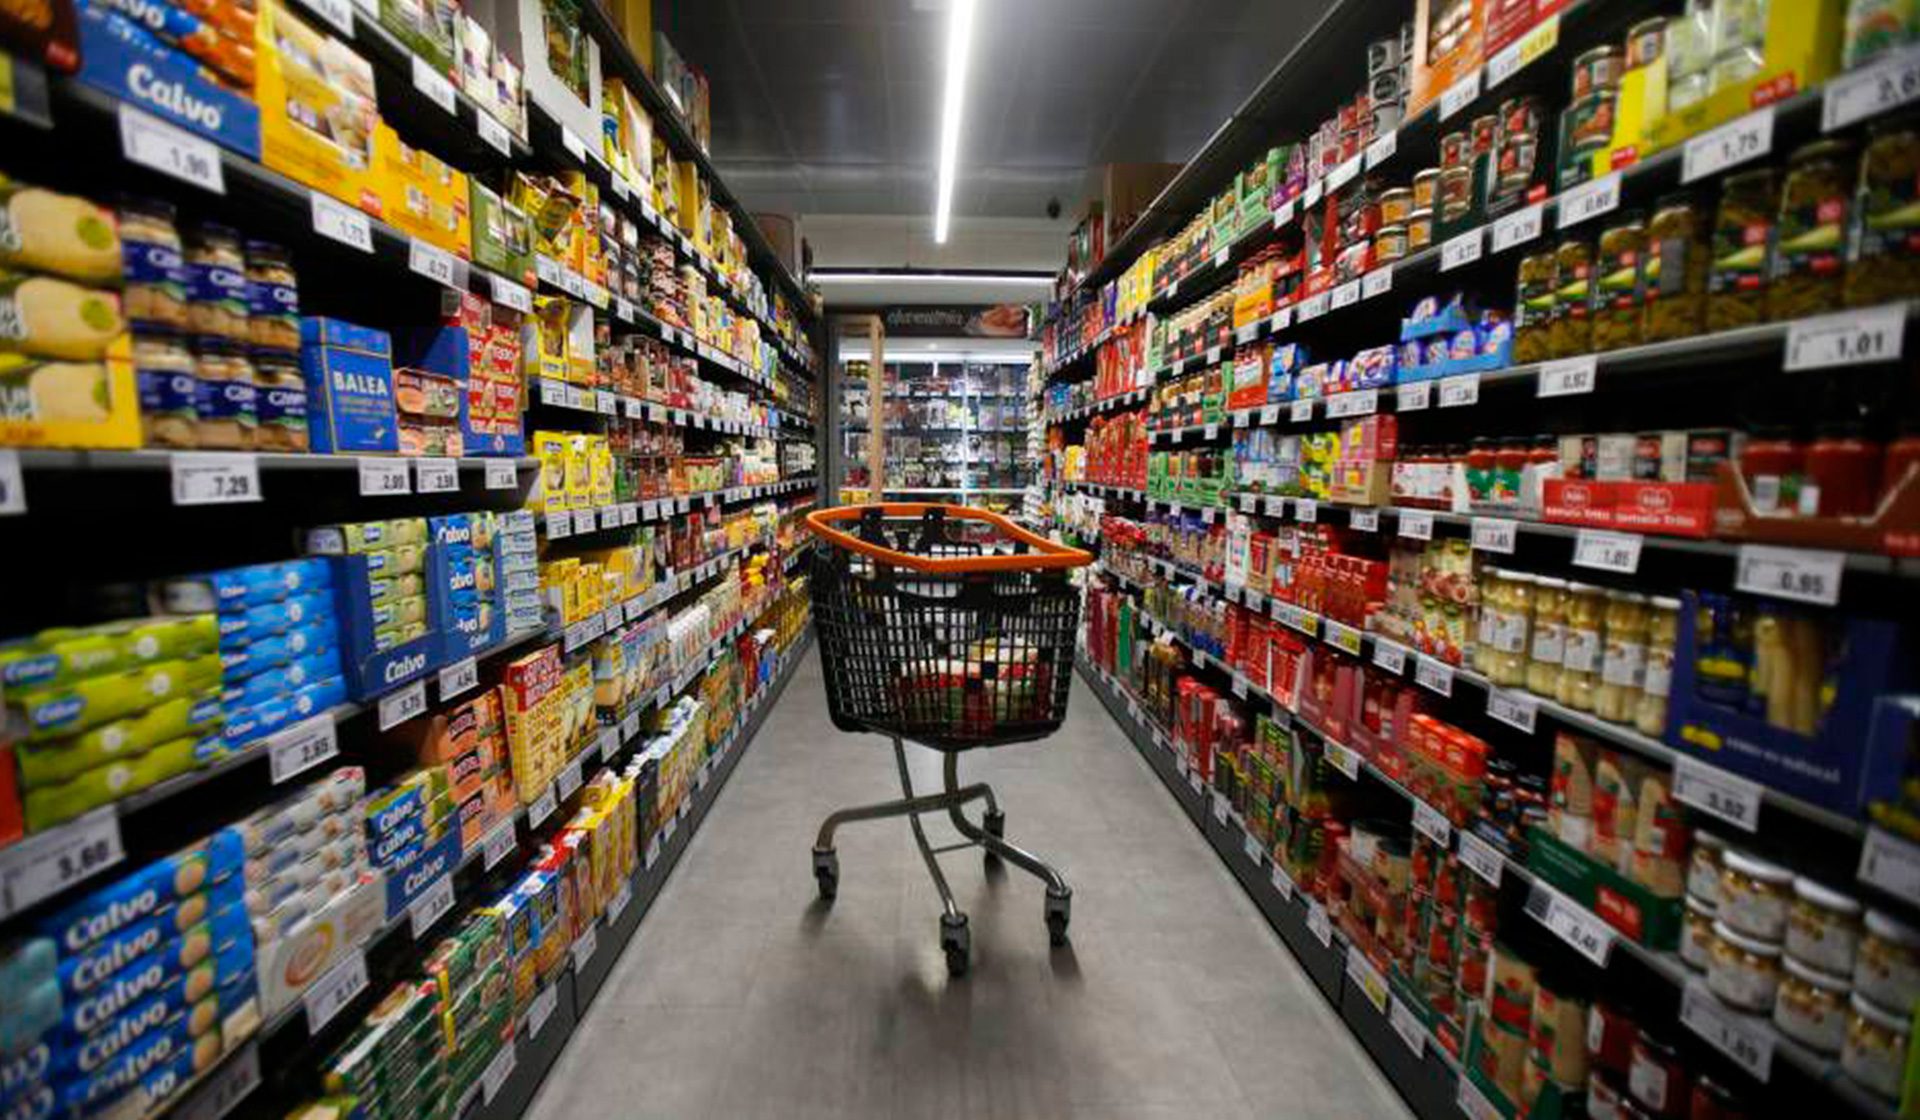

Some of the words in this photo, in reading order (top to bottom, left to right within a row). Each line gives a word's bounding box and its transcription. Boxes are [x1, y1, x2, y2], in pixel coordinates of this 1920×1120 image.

[127, 63, 221, 130] Calvo
[333, 371, 388, 397] BALEA
[451, 570, 474, 589] alvo
[385, 653, 426, 683] Calvo
[404, 854, 446, 896] Calvo
[66, 888, 157, 951] Calvo
[73, 927, 160, 991] Calvo
[74, 964, 164, 1033] Calvo
[78, 1001, 168, 1072] Calvo
